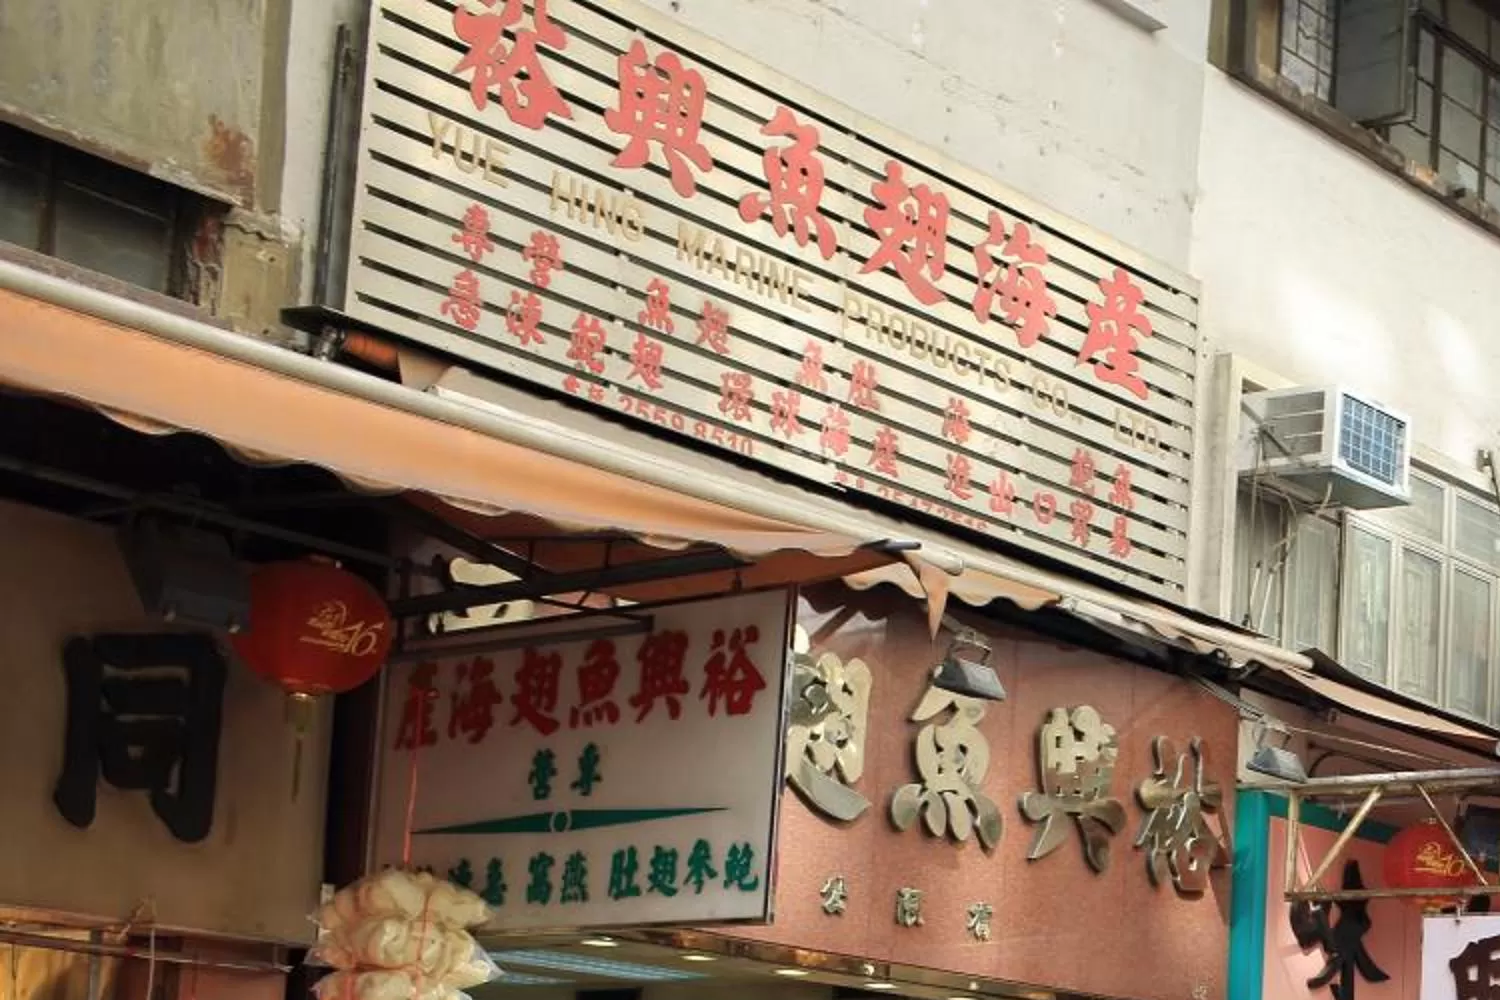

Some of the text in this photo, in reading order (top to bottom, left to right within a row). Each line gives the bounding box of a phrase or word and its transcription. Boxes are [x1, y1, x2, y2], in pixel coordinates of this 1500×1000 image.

[428, 112, 511, 189] YUE
[549, 169, 643, 242] HING
[677, 221, 812, 313] MARINE
[842, 291, 1012, 393] PRODUCTS
[453, 0, 1152, 400] 裕興魚翅海產
[527, 742, 605, 800] 專營
